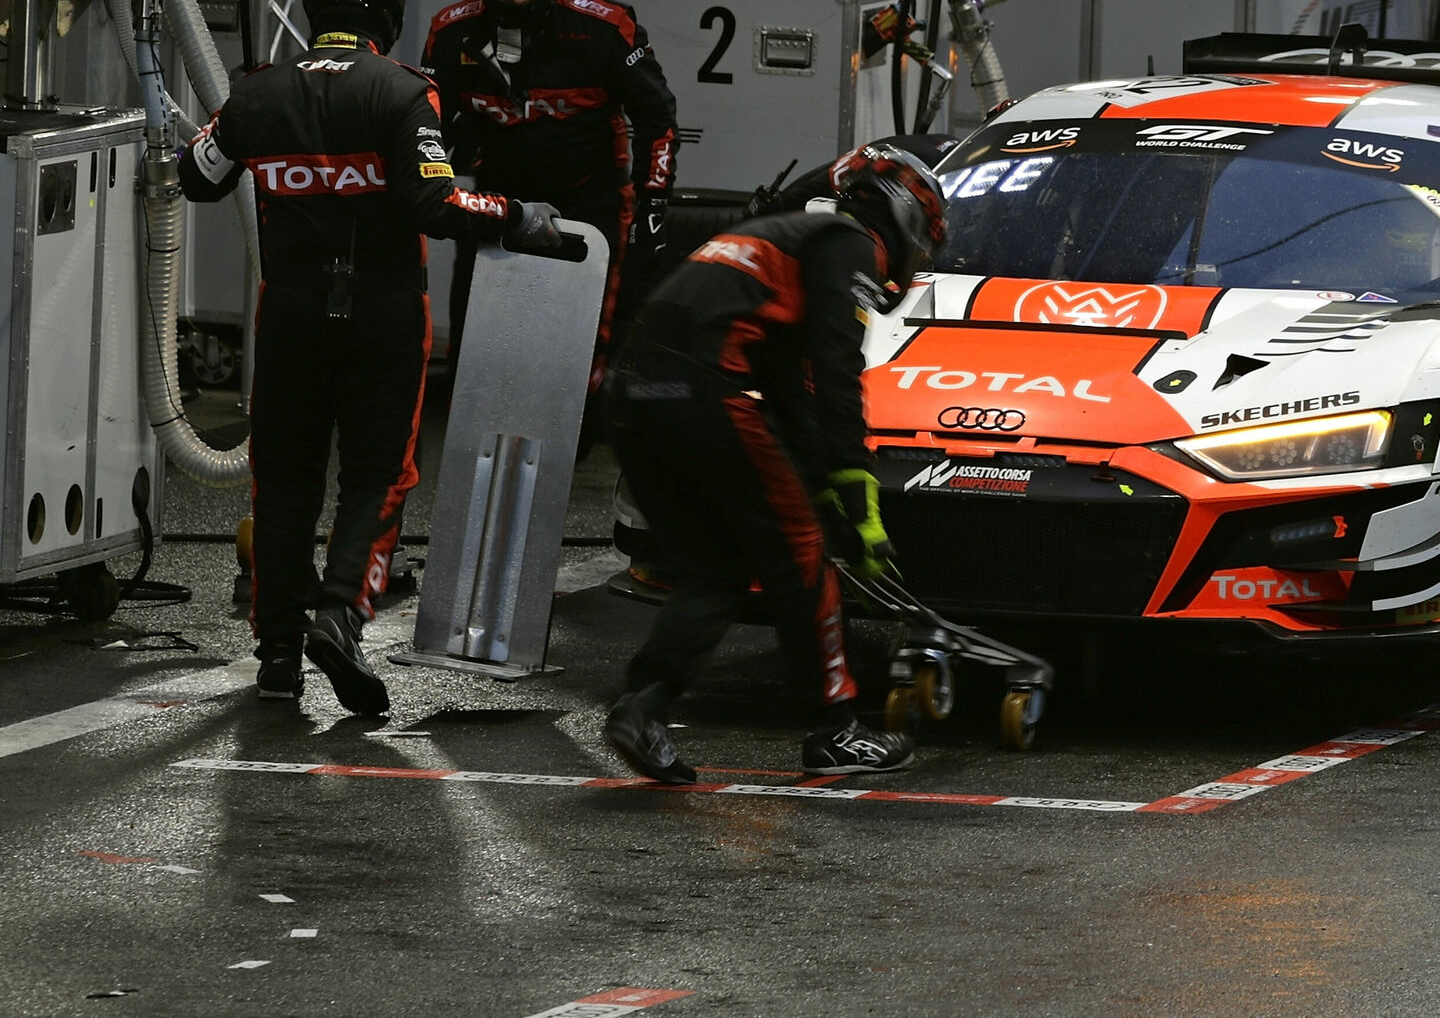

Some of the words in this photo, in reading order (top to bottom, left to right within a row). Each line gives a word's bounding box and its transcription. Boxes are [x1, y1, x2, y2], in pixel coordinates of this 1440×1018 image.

[696, 5, 737, 85] 2
[305, 58, 356, 72] WRT
[471, 96, 577, 125] TOTAL
[1006, 126, 1082, 147] aws
[1136, 124, 1274, 142] GT
[1136, 140, 1178, 148] WORLD
[1179, 141, 1247, 151] CHALLENGE
[1326, 137, 1405, 163] aws
[257, 160, 385, 192] TOTAL
[458, 192, 506, 218] TOTAL
[890, 366, 1112, 403] TOTAL
[1200, 391, 1361, 430] SKECHERS
[949, 477, 1030, 493] COMPETIZIONE
[955, 465, 1000, 480] ASSETTO
[999, 467, 1032, 481] CORSA
[1210, 576, 1322, 600] TOTAL
